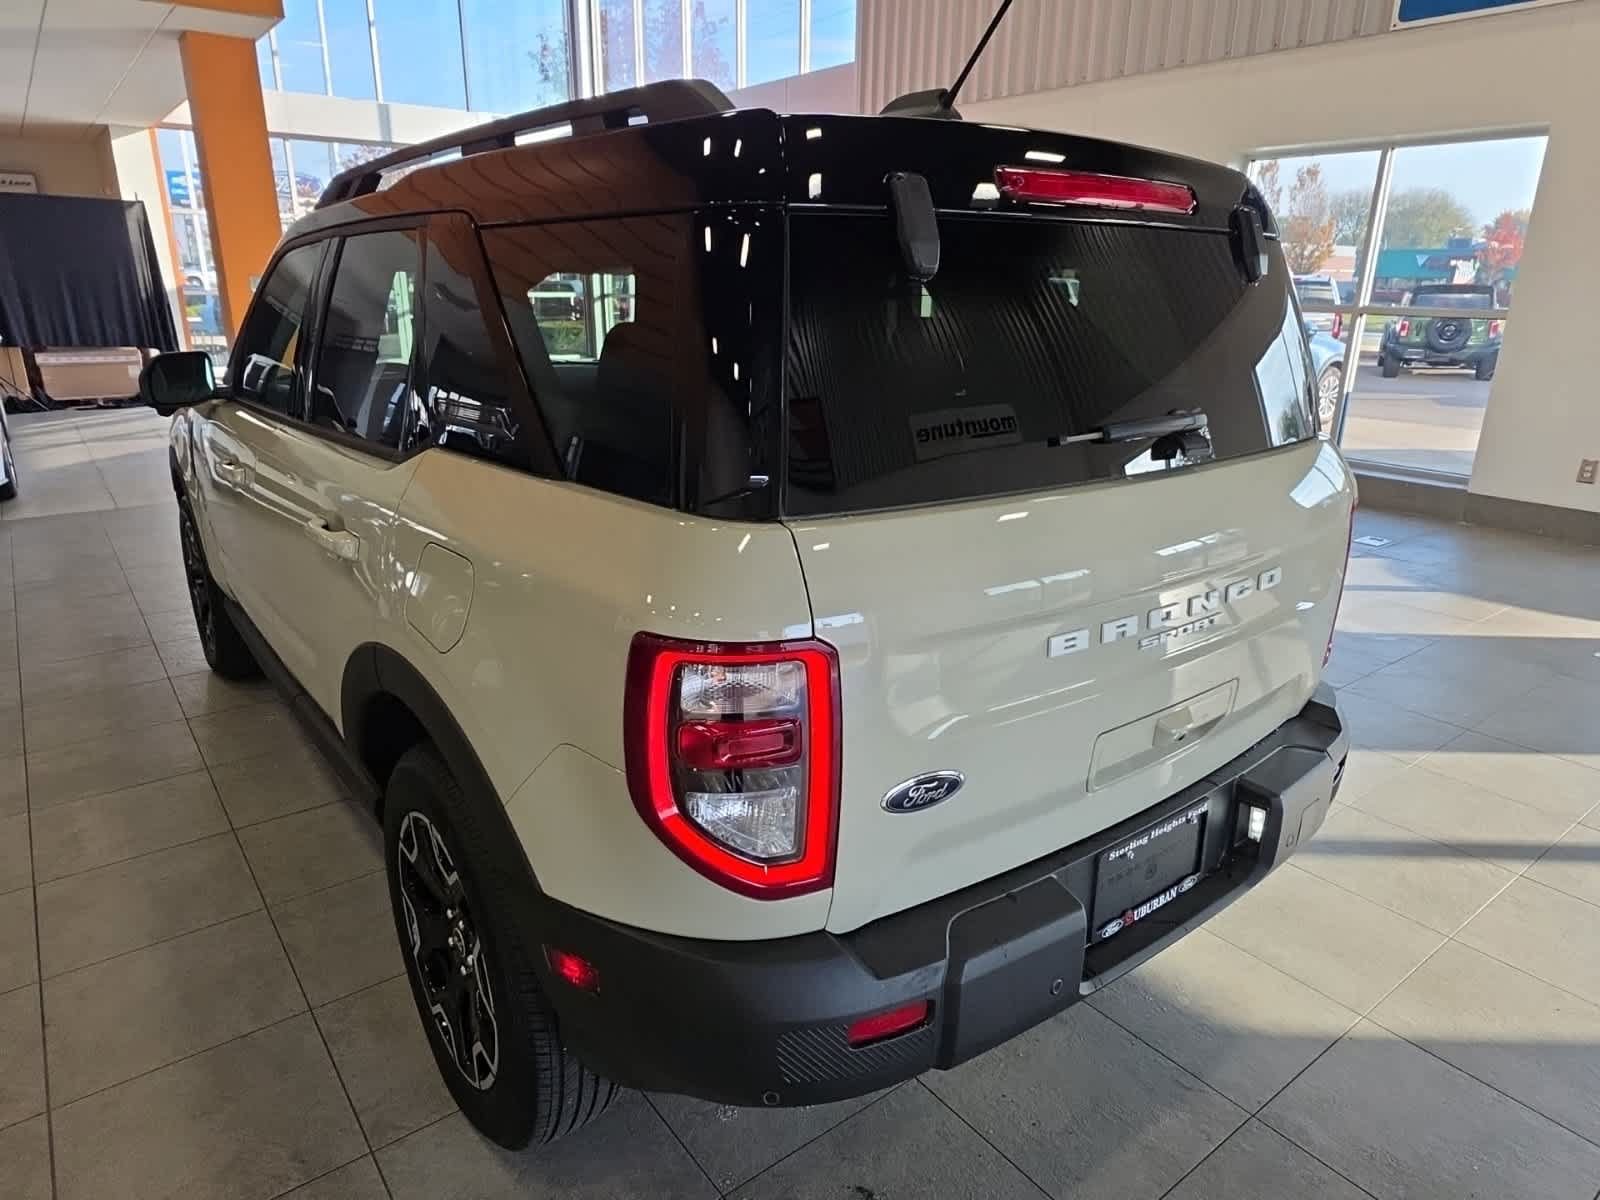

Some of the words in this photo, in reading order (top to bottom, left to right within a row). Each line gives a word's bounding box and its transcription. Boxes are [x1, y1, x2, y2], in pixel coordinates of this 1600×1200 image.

[1047, 567, 1281, 657] BRONCO
[1138, 613, 1222, 649] SPORT
[1109, 835, 1149, 861] Sterling
[1151, 816, 1186, 840] Heights
[1187, 802, 1208, 820] Ford
[1125, 886, 1178, 926] SUBURBAN
